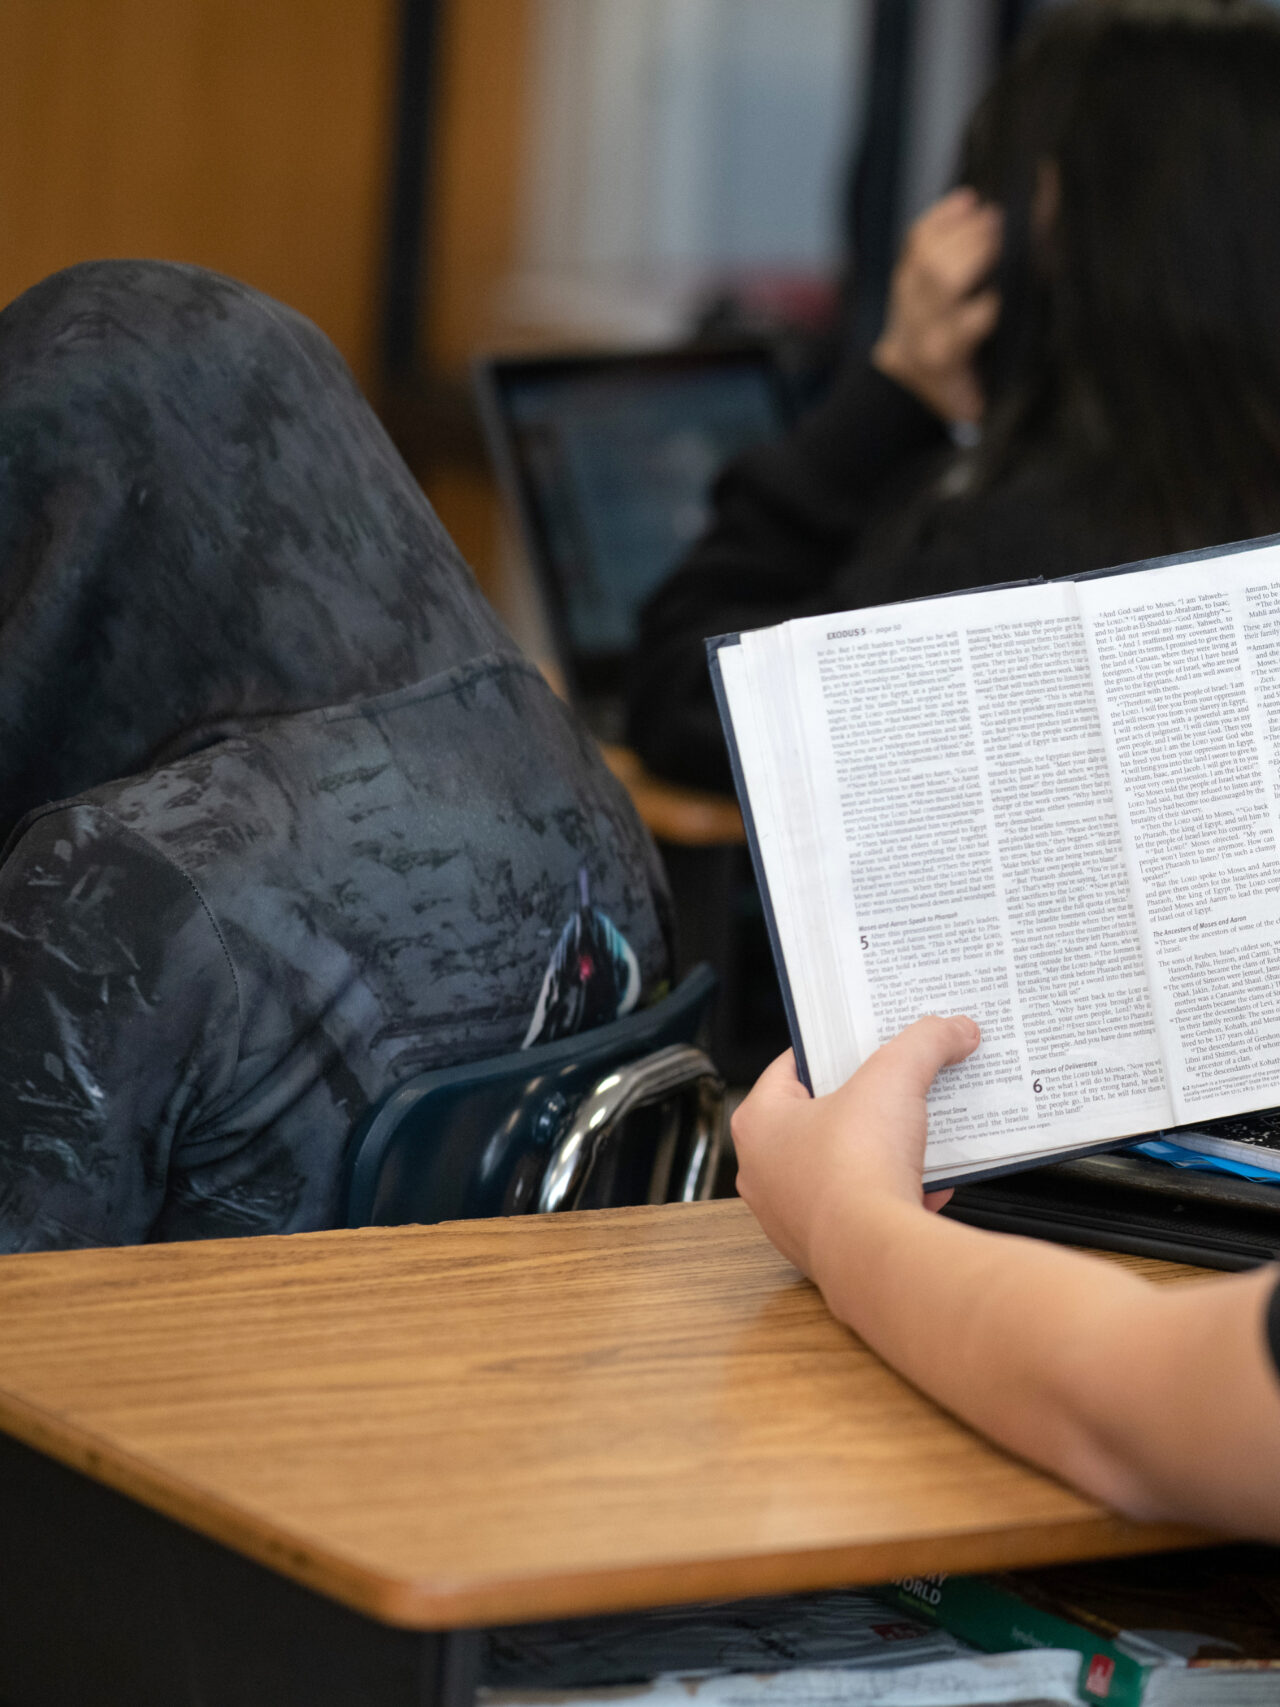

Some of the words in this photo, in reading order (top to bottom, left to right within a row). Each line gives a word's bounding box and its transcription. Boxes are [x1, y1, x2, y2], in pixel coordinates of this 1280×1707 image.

[1249, 609, 1267, 617] Mahli
[827, 629, 860, 639] EXODUS
[1119, 690, 1146, 700] covenant
[1131, 815, 1156, 824] brutality
[934, 912, 958, 920] Pharaoh
[1164, 926, 1191, 935] Ancestors
[860, 935, 869, 950] 5
[1169, 970, 1206, 982] descendants
[1207, 966, 1230, 974] became
[1182, 1039, 1197, 1047] lived
[1031, 1067, 1057, 1075] Promises
[1065, 1061, 1098, 1070] Deliverance
[1033, 1078, 1043, 1093] 6
